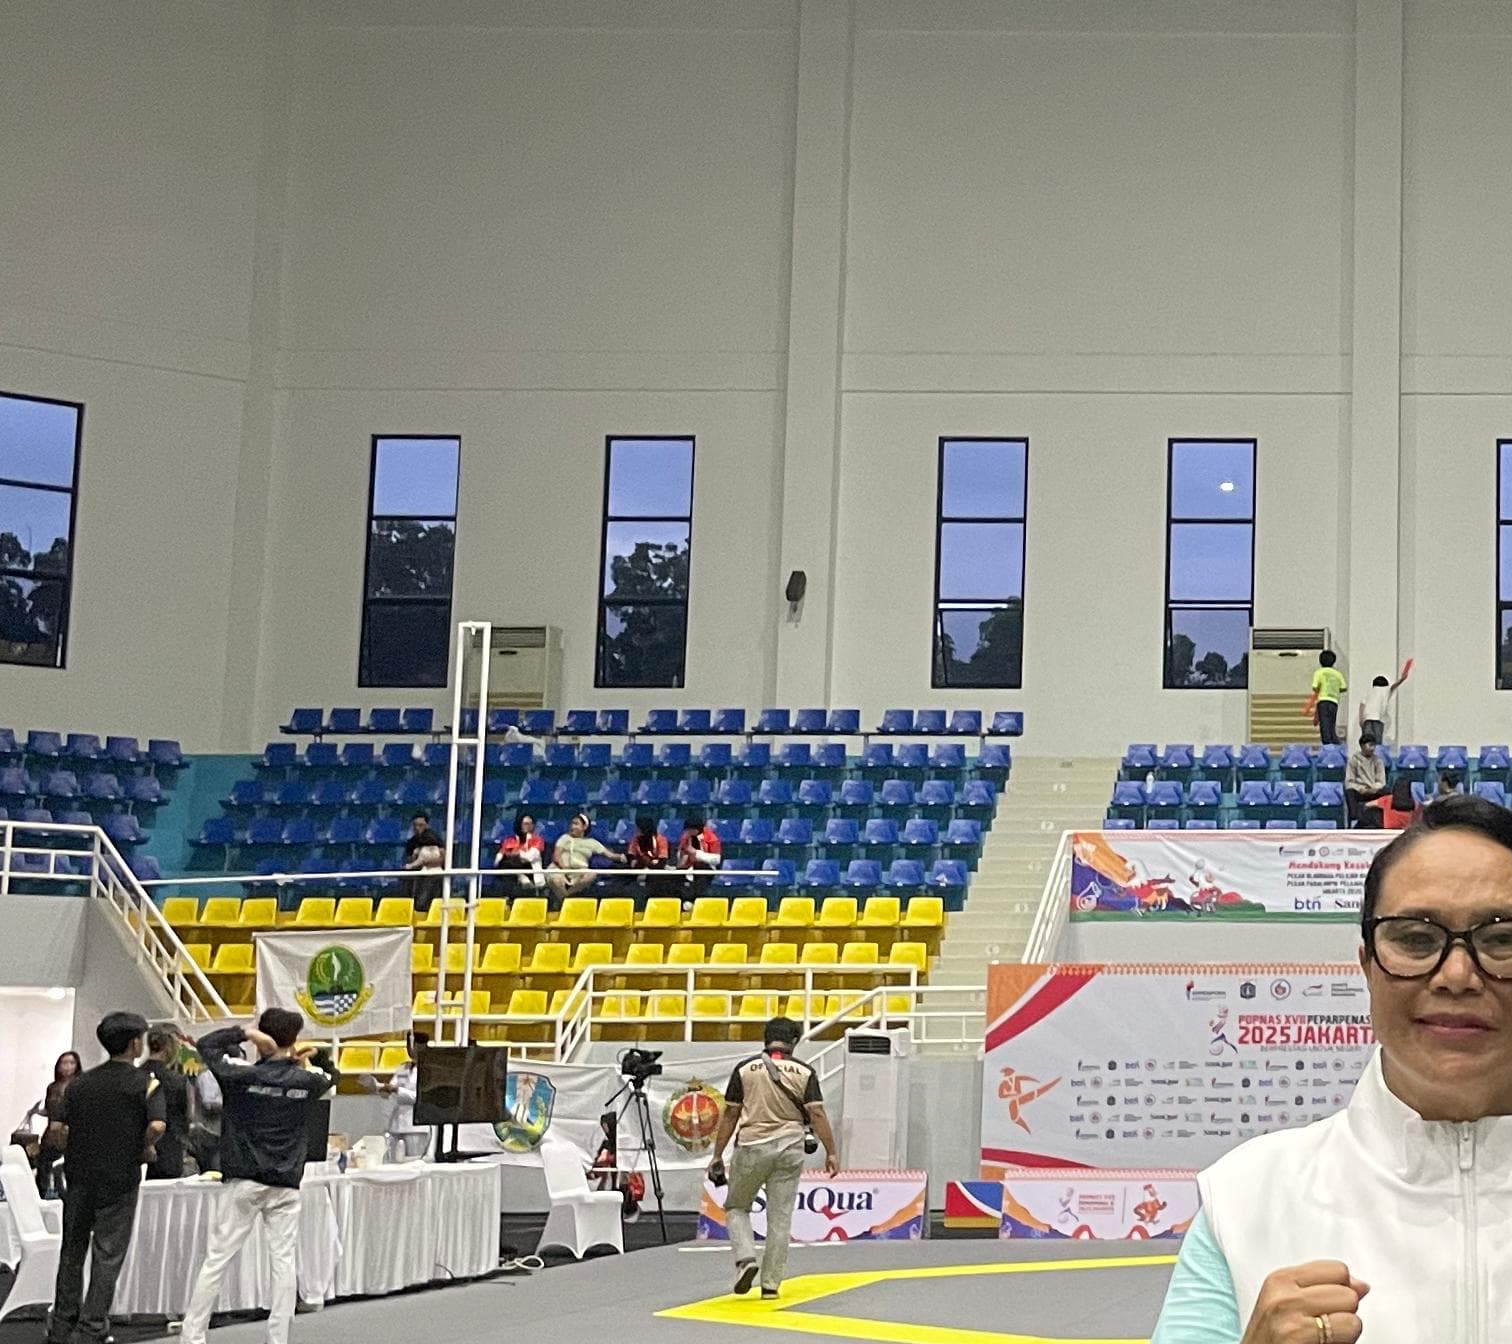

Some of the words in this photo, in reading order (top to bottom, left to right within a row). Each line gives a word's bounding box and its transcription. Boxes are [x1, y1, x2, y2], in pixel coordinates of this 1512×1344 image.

[1238, 1015, 1281, 1025] POPNAS
[1307, 1015, 1371, 1025] PEPARPENAS
[1238, 1026, 1291, 1044] 2025
